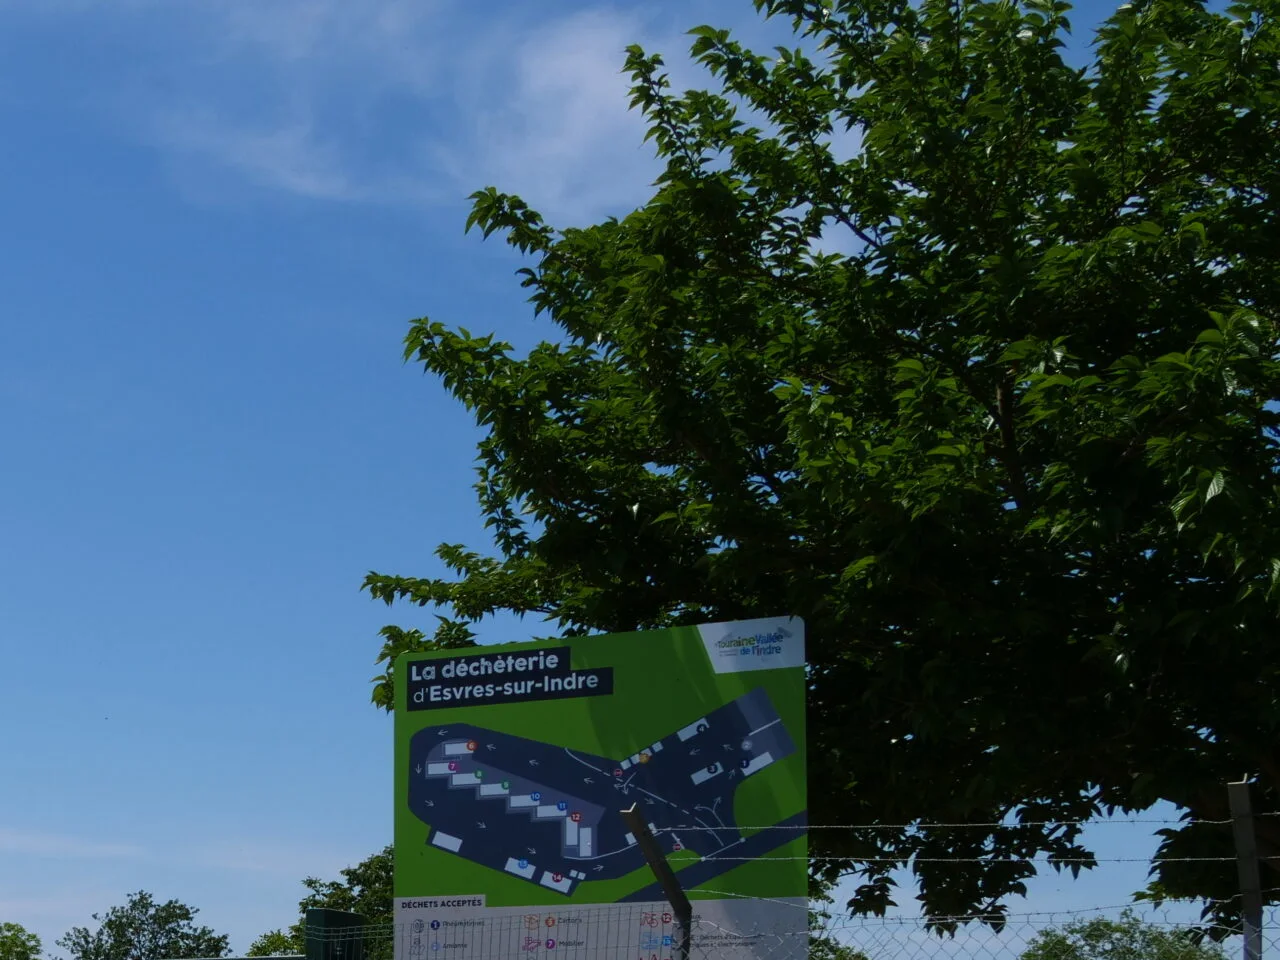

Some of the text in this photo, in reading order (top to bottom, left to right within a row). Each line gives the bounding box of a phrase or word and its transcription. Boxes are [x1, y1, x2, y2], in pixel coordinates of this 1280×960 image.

[740, 647, 751, 656] de
[411, 651, 559, 681] La déchèterie
[413, 672, 599, 703] d'Esvres-sur-Indre
[401, 896, 482, 909] DÉCHETS ACCEPTÉS
